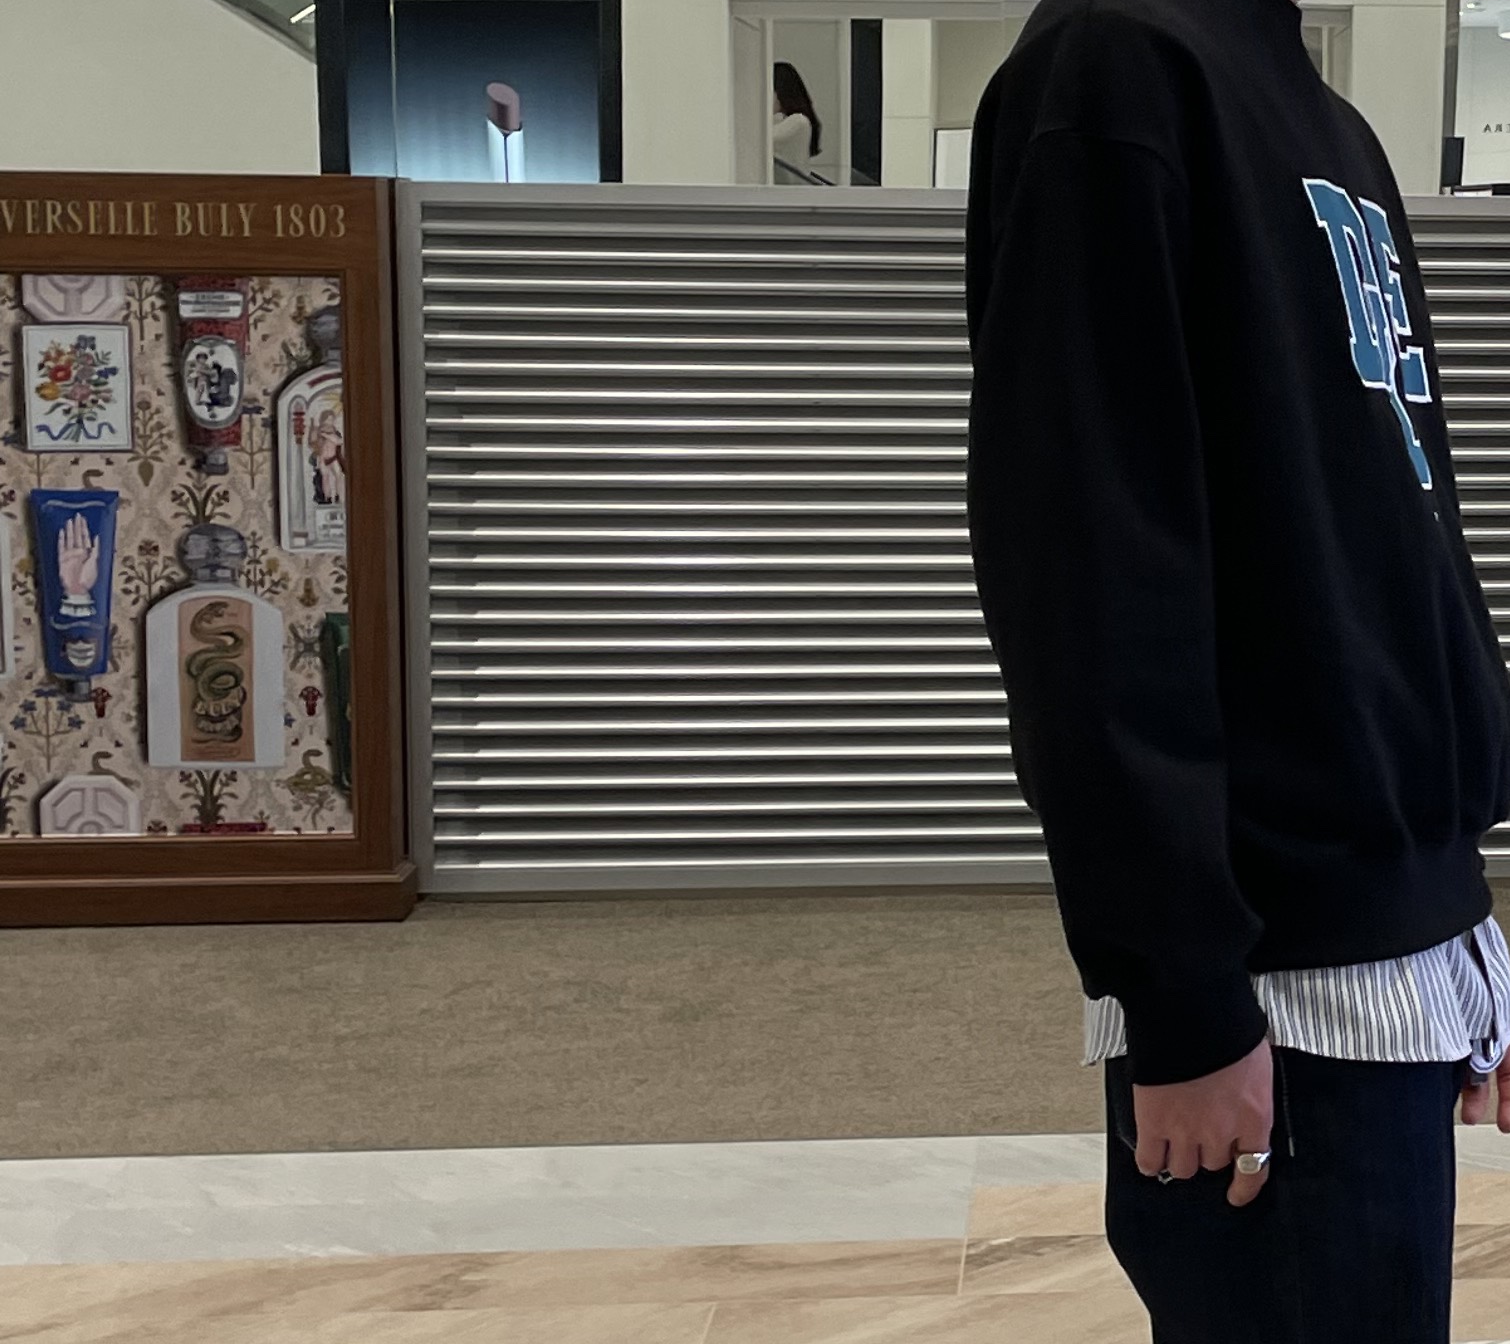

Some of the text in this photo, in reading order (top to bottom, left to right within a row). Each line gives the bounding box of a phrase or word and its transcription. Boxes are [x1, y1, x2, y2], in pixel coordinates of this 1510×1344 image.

[0, 199, 346, 238] VERSELLE BULY 1803
